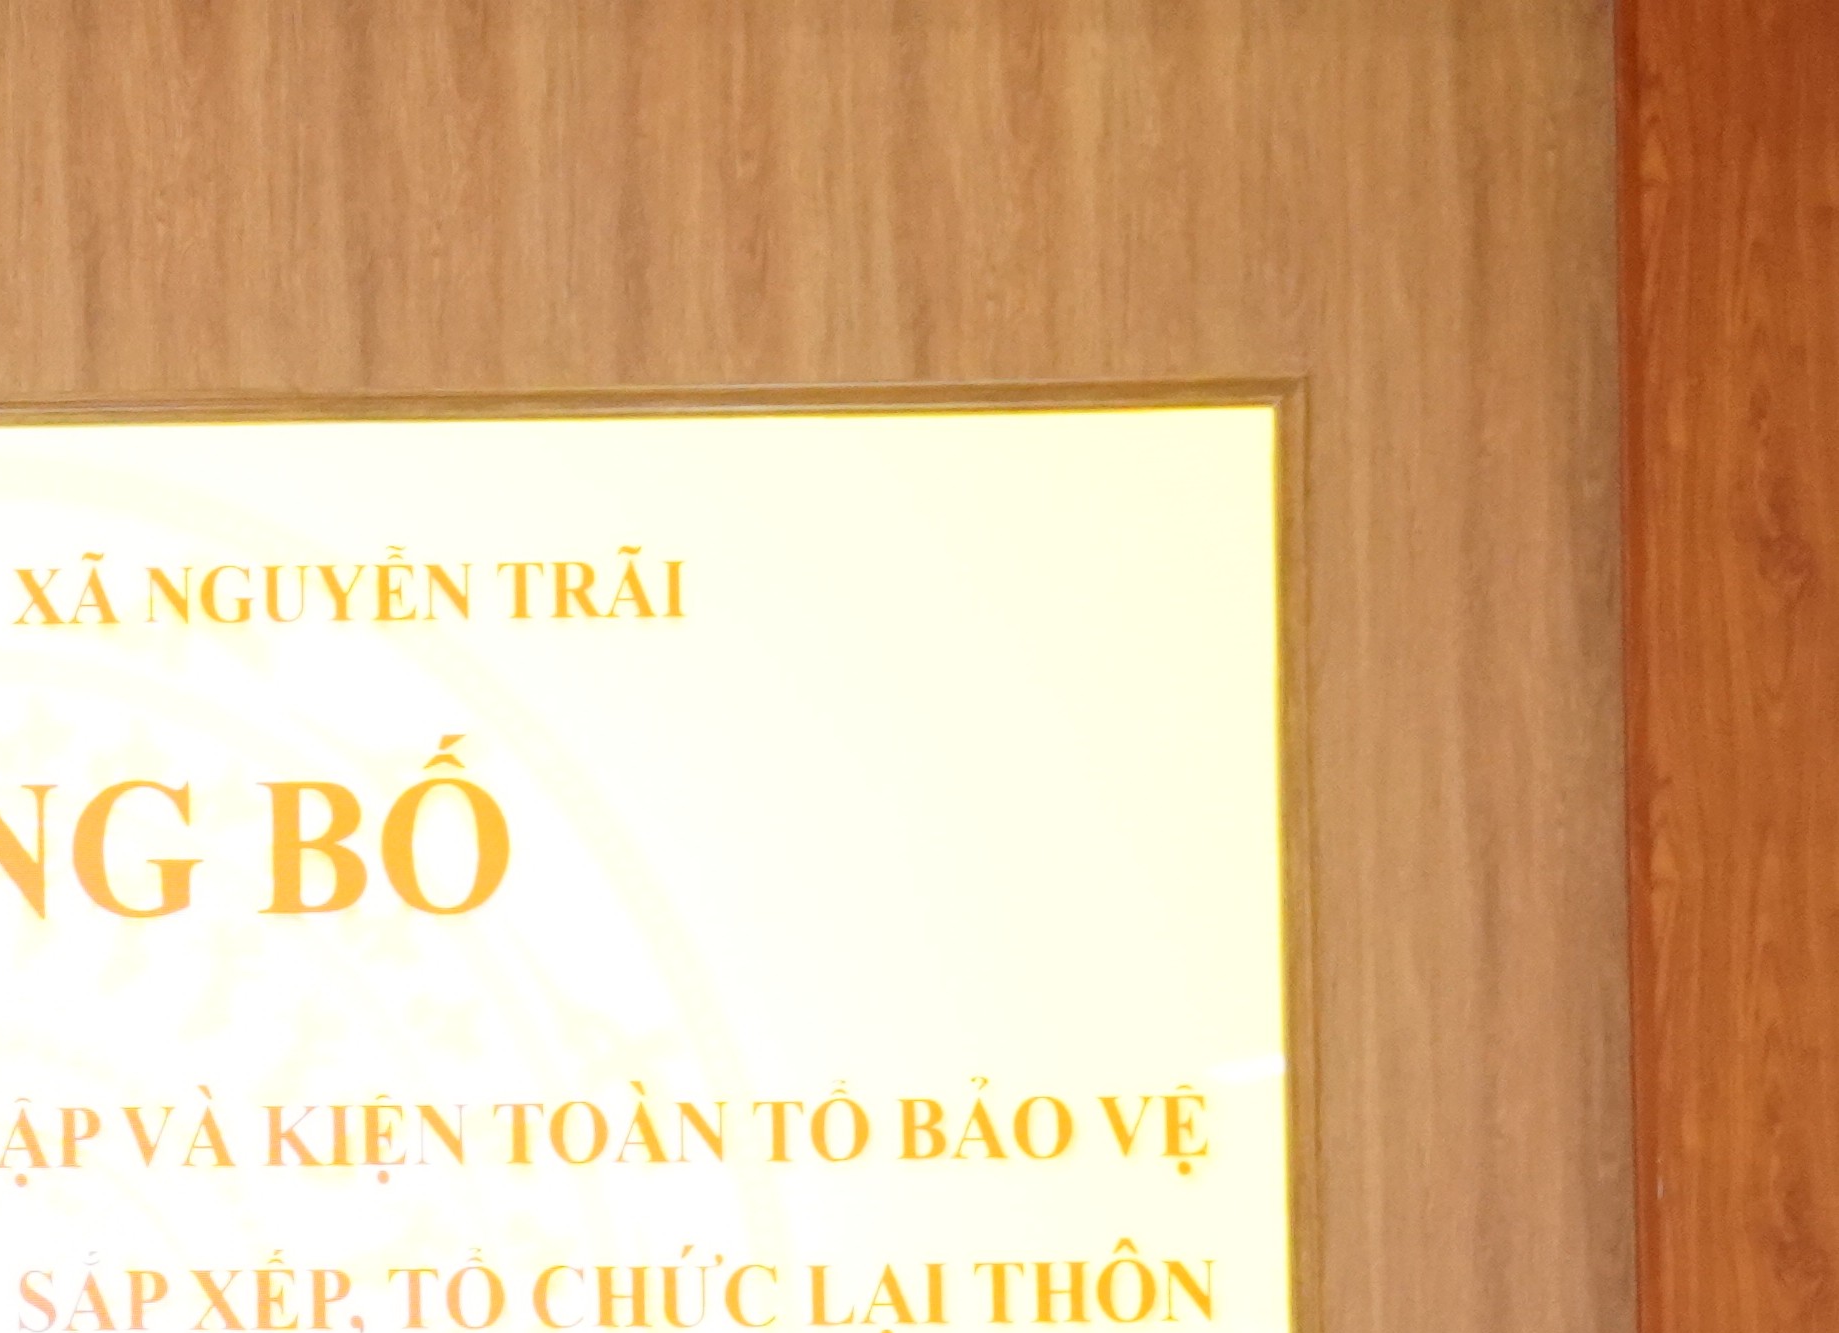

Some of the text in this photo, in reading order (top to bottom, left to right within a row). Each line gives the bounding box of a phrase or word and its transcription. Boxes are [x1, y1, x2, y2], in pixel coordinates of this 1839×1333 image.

[14, 550, 120, 628] XÃ
[145, 545, 471, 625] NGUYỄN
[496, 544, 685, 622] TRÃI
[257, 732, 512, 918] BỐ
[121, 1083, 237, 1169] VÀ
[264, 1093, 466, 1186] KIỆN
[492, 1079, 726, 1167] TOÀN
[752, 1080, 872, 1164] TỔ
[899, 1077, 1076, 1162] BẢO
[1098, 1084, 1209, 1177] VỆ
[17, 1250, 171, 1333] SẮP
[387, 1248, 508, 1331] TỔ
[530, 1243, 778, 1331] CHỨC
[973, 1236, 1215, 1326] THÔN
